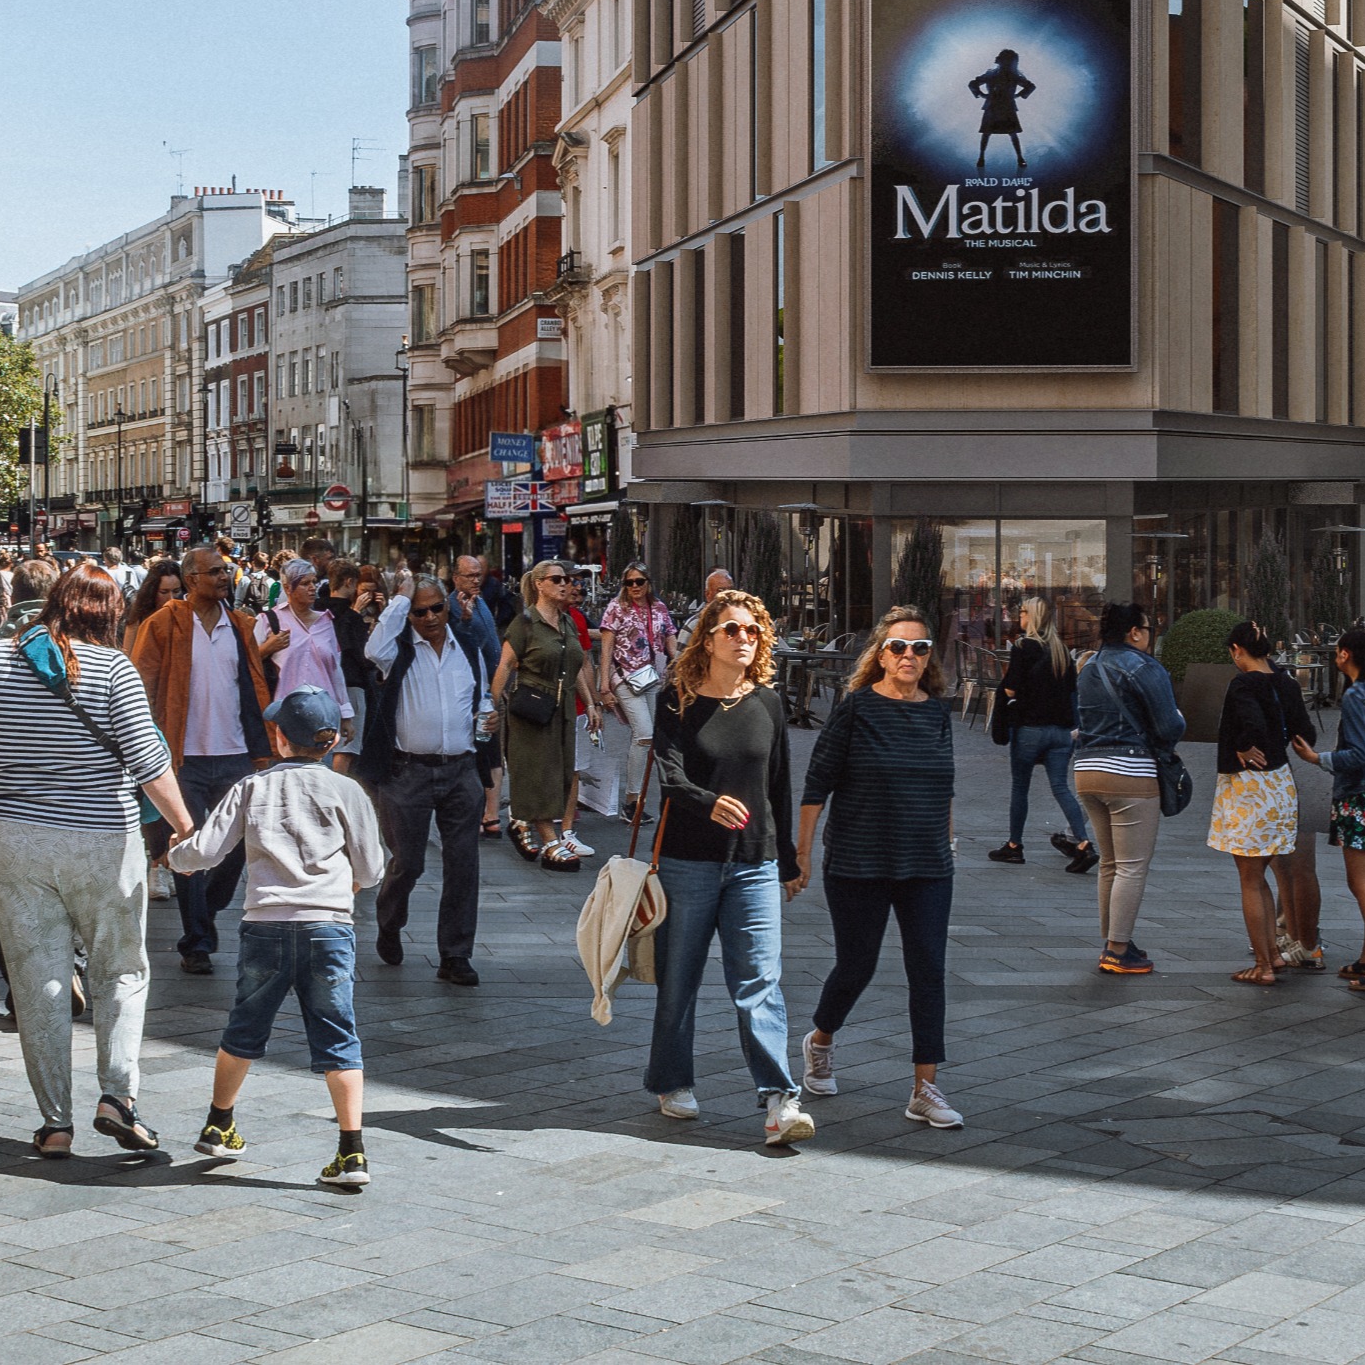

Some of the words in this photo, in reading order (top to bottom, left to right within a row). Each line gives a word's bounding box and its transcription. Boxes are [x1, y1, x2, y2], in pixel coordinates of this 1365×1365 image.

[965, 178, 998, 187] ROALD
[893, 184, 1112, 239] Matilda
[912, 271, 955, 280] DENNIS
[958, 271, 992, 279] KELLY
[1009, 271, 1029, 279] TIM
[1032, 270, 1081, 279] MINCHIN
[497, 437, 527, 446] MONEY
[493, 449, 529, 457] CHANGE
